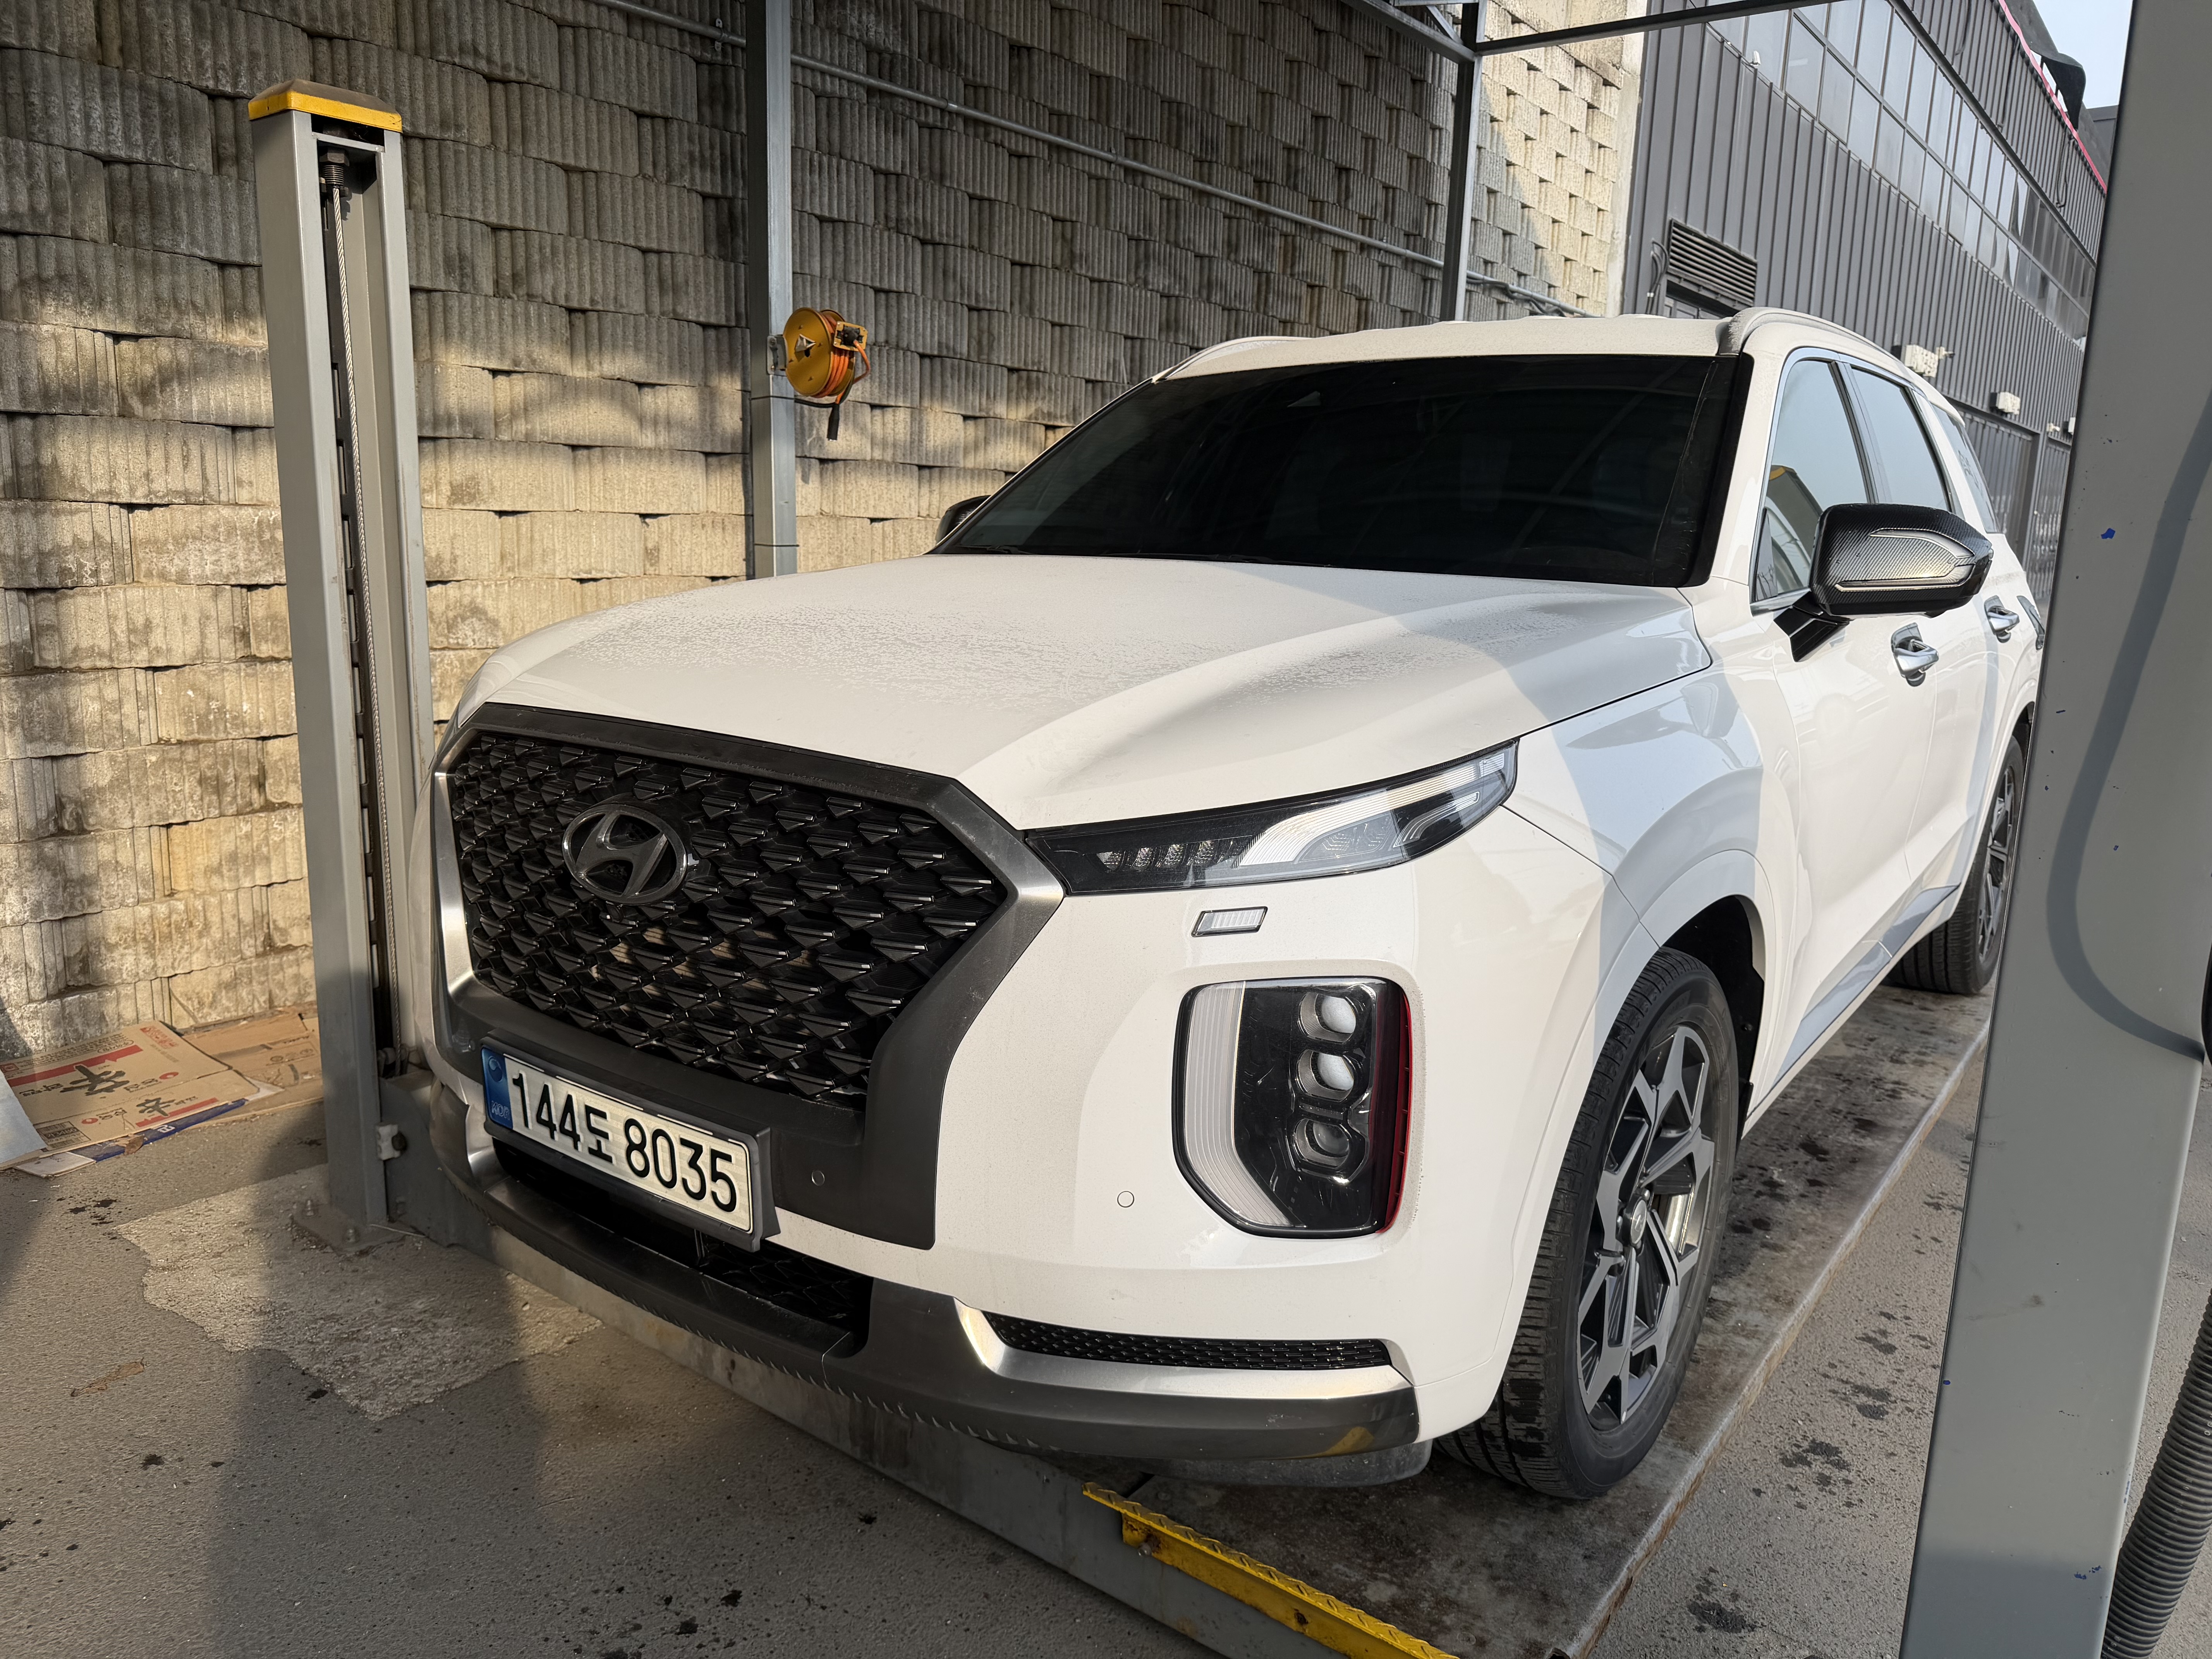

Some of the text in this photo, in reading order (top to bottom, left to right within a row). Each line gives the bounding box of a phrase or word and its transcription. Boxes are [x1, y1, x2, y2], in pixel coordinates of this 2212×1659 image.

[491, 1100, 510, 1121] KOR
[512, 1073, 737, 1212] 144도 8035
